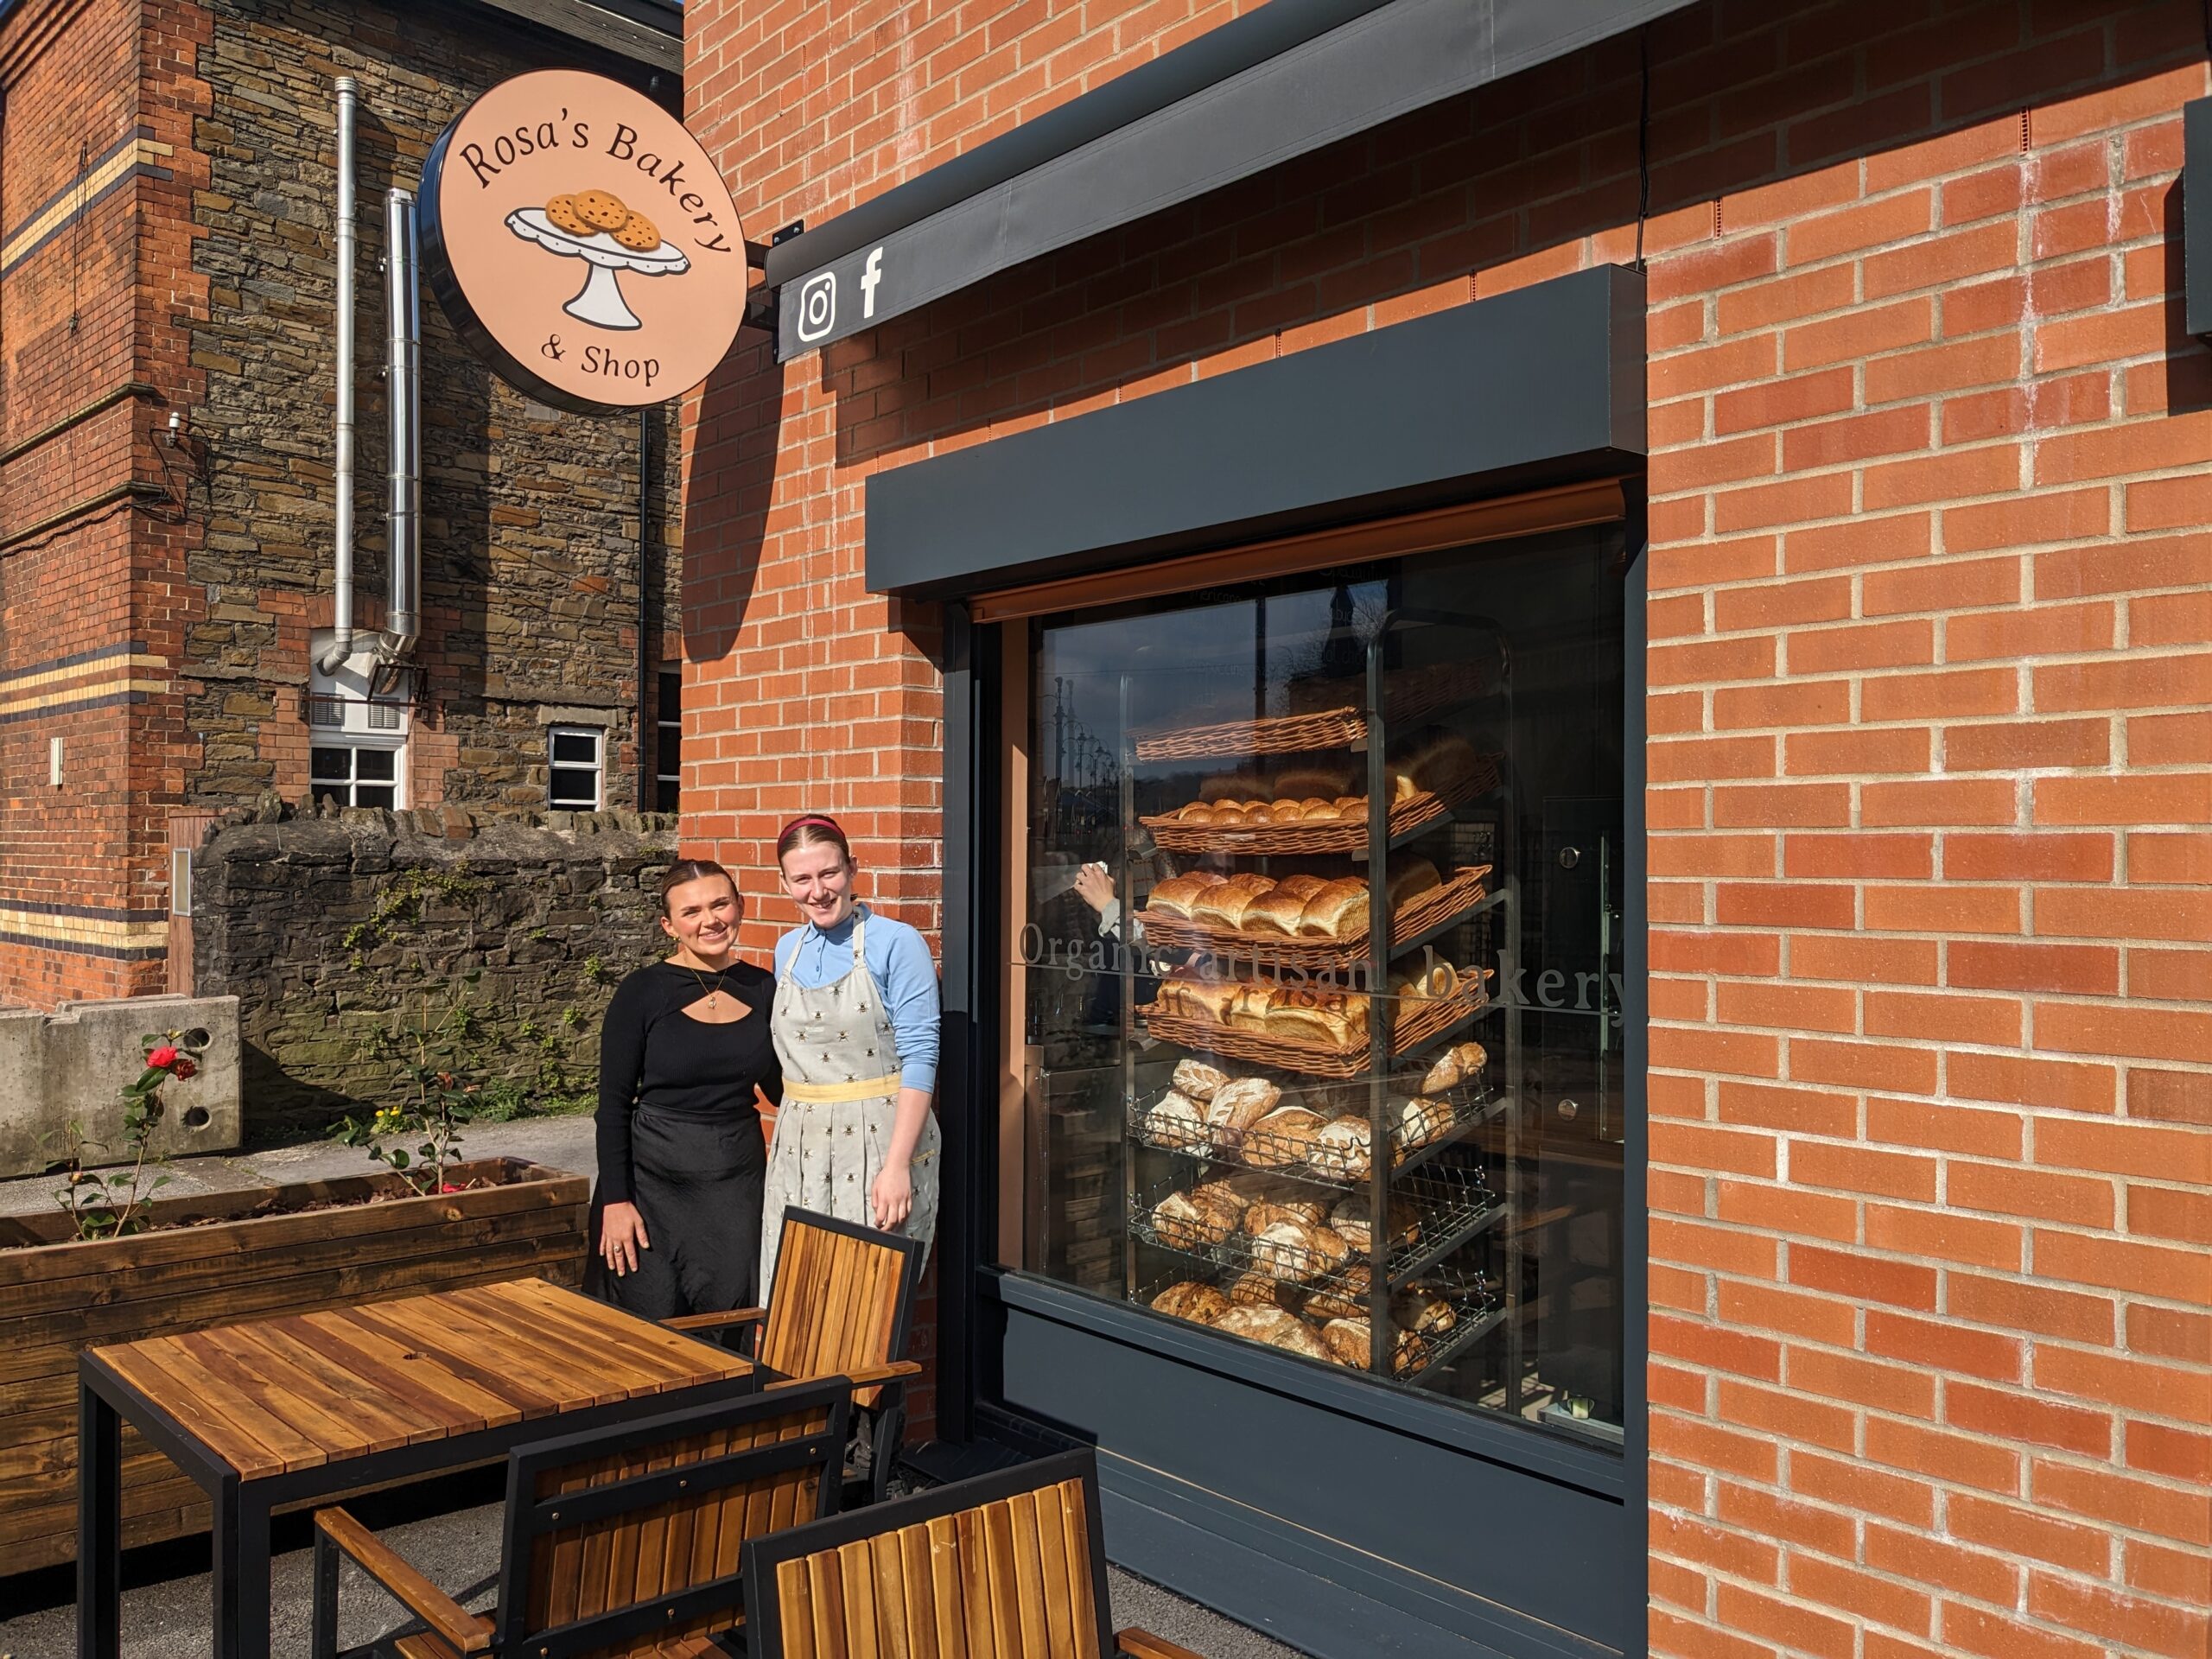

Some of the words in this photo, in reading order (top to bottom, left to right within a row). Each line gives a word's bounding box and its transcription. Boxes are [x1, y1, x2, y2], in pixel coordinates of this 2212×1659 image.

[459, 108, 589, 189] Rosa's
[606, 124, 732, 253] Bakery
[542, 334, 566, 362] &
[582, 346, 660, 387] Shop
[1019, 922, 1173, 981] Organic
[1199, 940, 1376, 992] artisan
